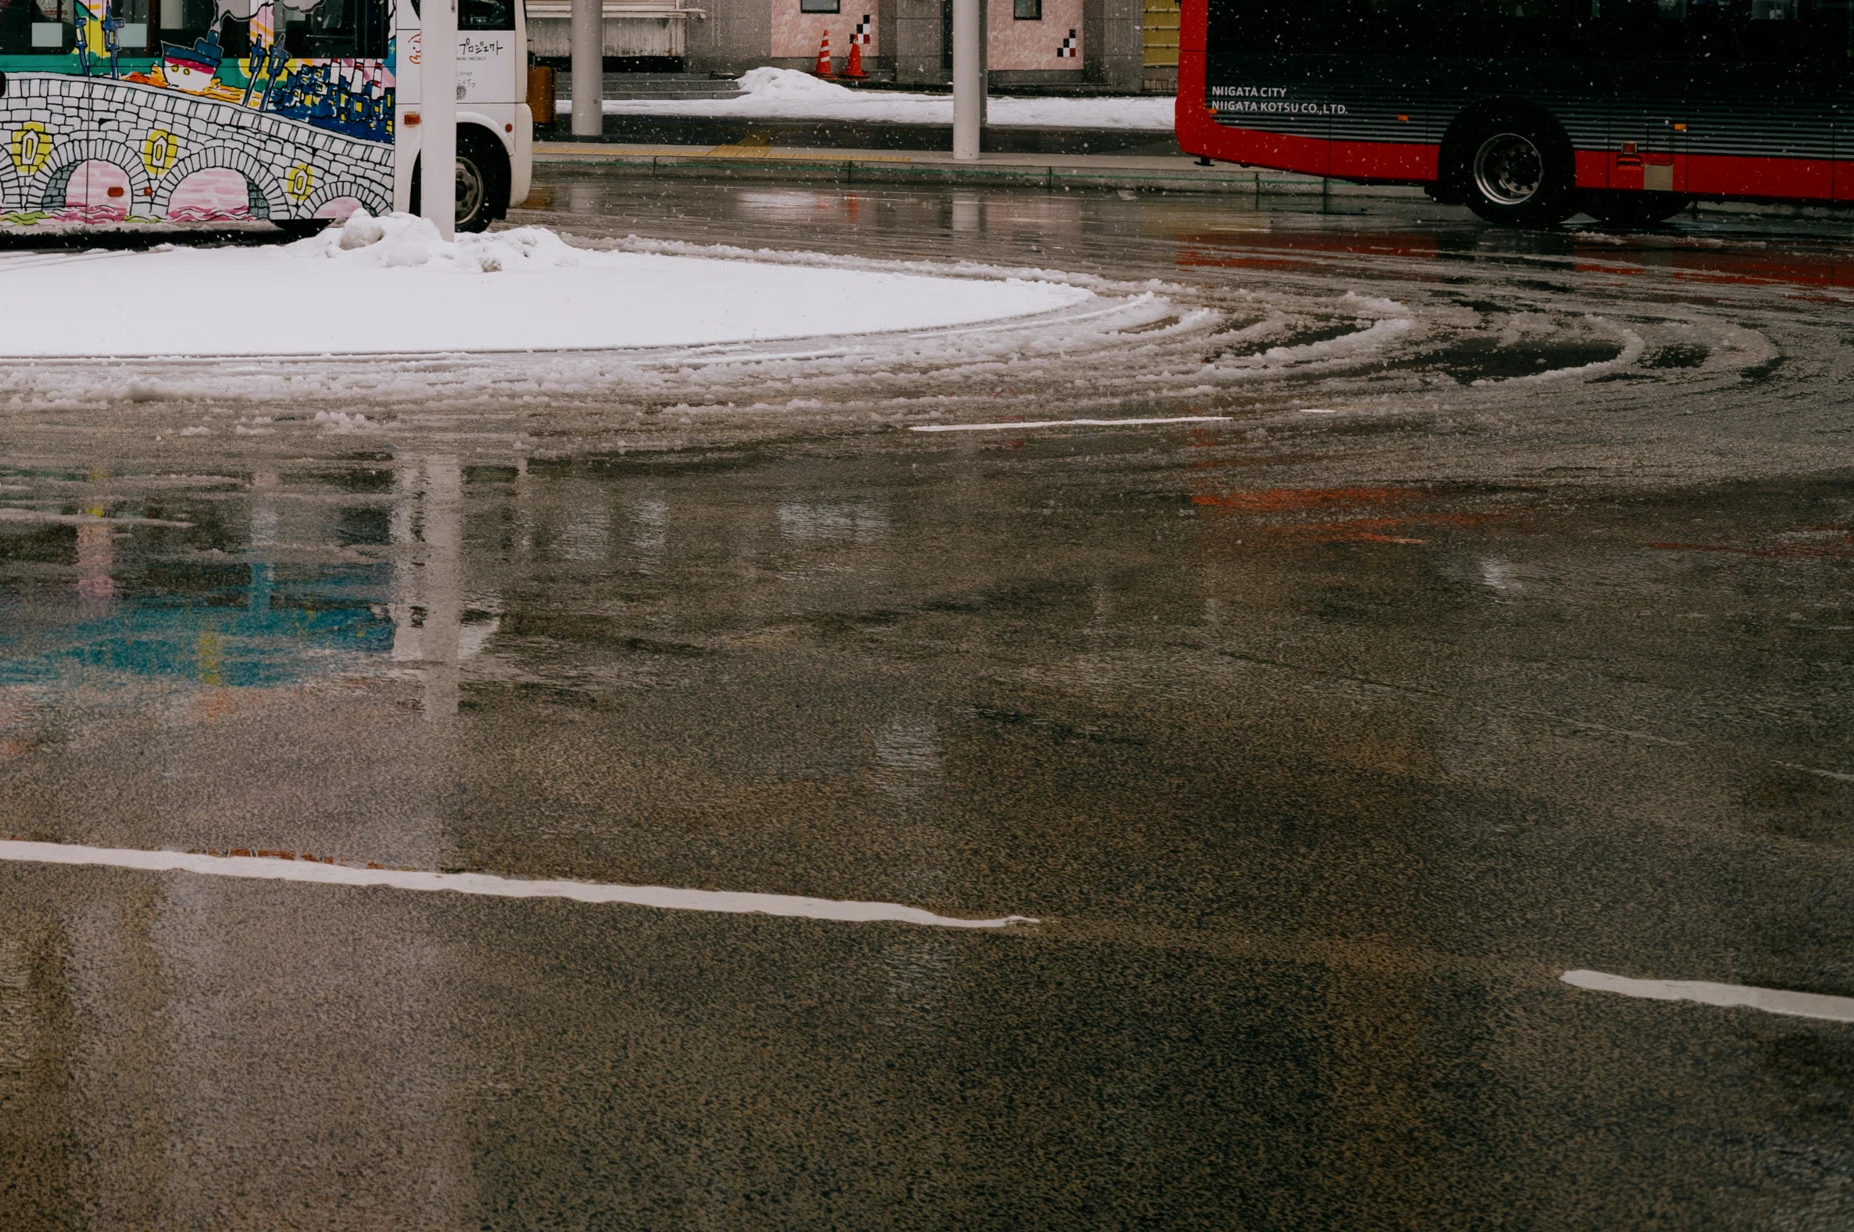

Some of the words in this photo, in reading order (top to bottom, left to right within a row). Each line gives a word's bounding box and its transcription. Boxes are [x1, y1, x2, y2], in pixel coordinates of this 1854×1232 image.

[1212, 86, 1258, 97] NIIGATA
[1260, 87, 1287, 98] CITY
[1212, 100, 1258, 112] NIIGATA
[1260, 101, 1299, 113] KOTSU
